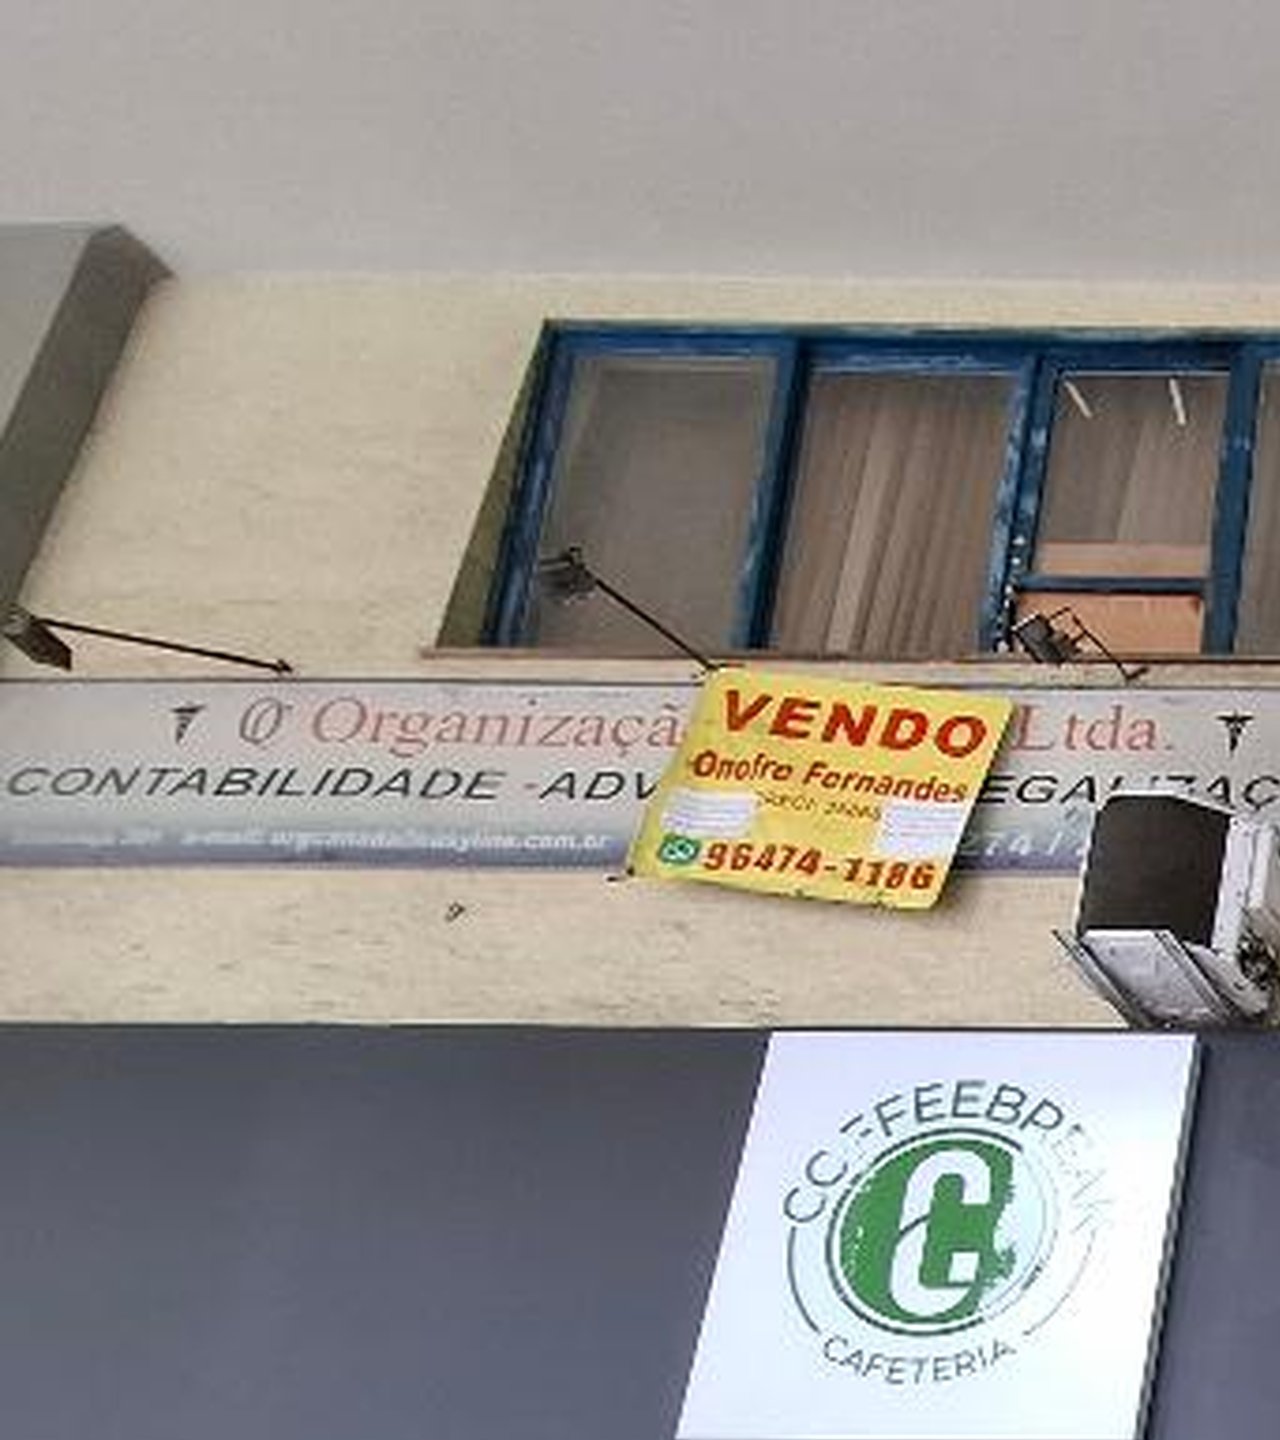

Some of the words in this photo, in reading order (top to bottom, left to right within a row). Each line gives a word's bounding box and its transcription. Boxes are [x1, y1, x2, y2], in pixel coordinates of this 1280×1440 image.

[312, 697, 684, 758] Organizaçã
[1015, 703, 1175, 752] Ltda.
[724, 689, 988, 758] VENDO
[8, 767, 508, 799] CONTABILIDADE
[692, 749, 793, 782] Onofre
[802, 762, 969, 802] Fernandes
[703, 842, 936, 890] 96474-1186
[822, 1334, 1017, 1385] CAFETERIA
